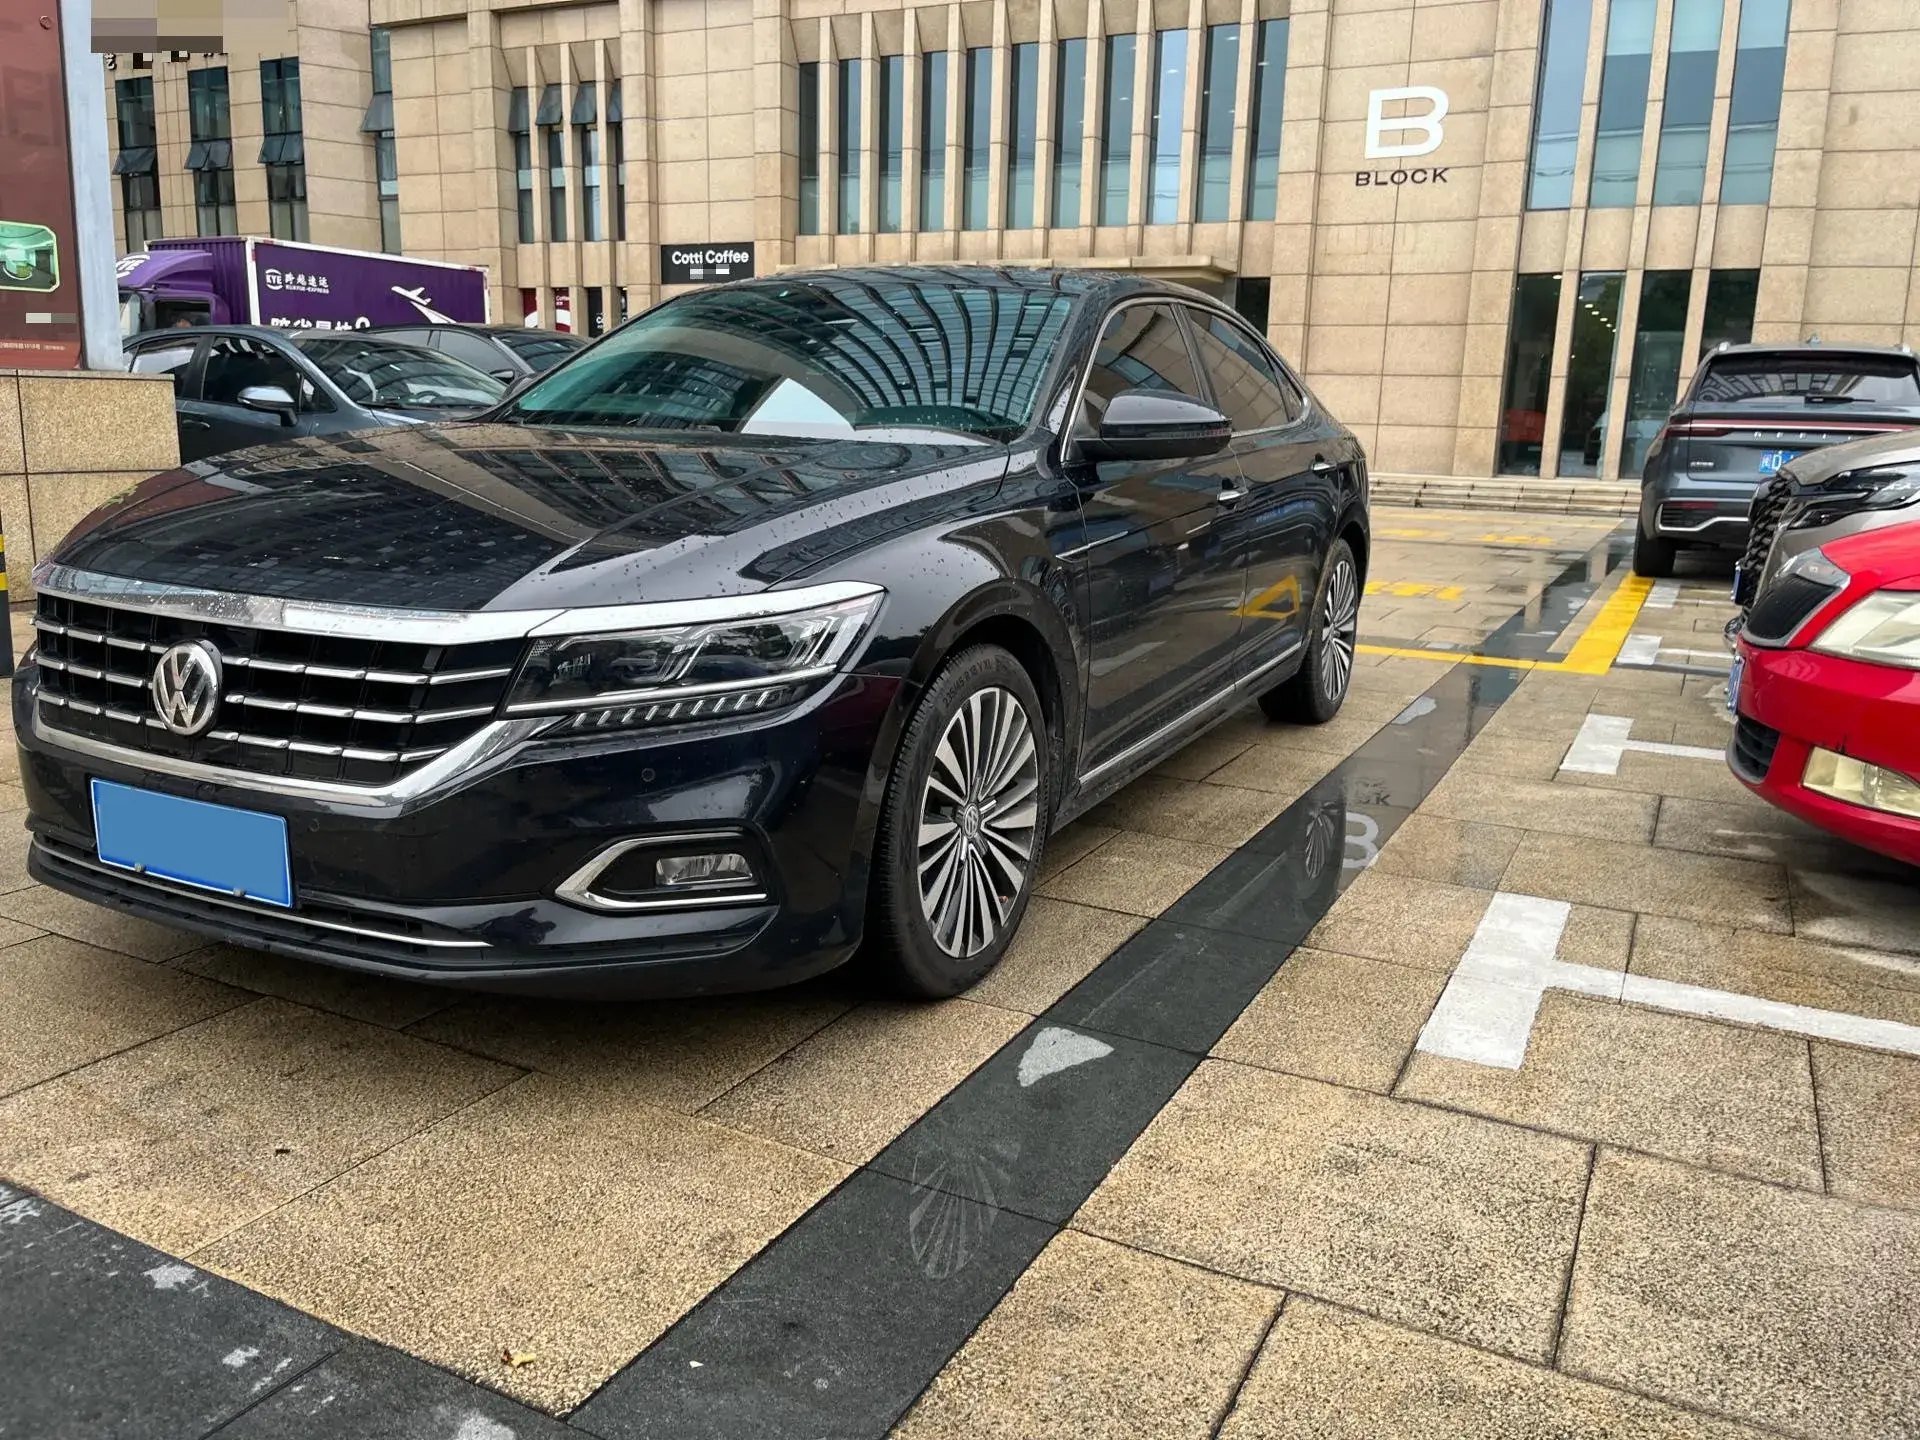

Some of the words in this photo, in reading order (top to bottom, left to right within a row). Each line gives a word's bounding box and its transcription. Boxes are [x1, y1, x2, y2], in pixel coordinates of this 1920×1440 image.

[1364, 86, 1449, 160] B
[1355, 168, 1449, 186] BLOCK
[672, 251, 703, 265] Cotti
[705, 250, 749, 264] Coffee
[265, 274, 283, 285] KYE
